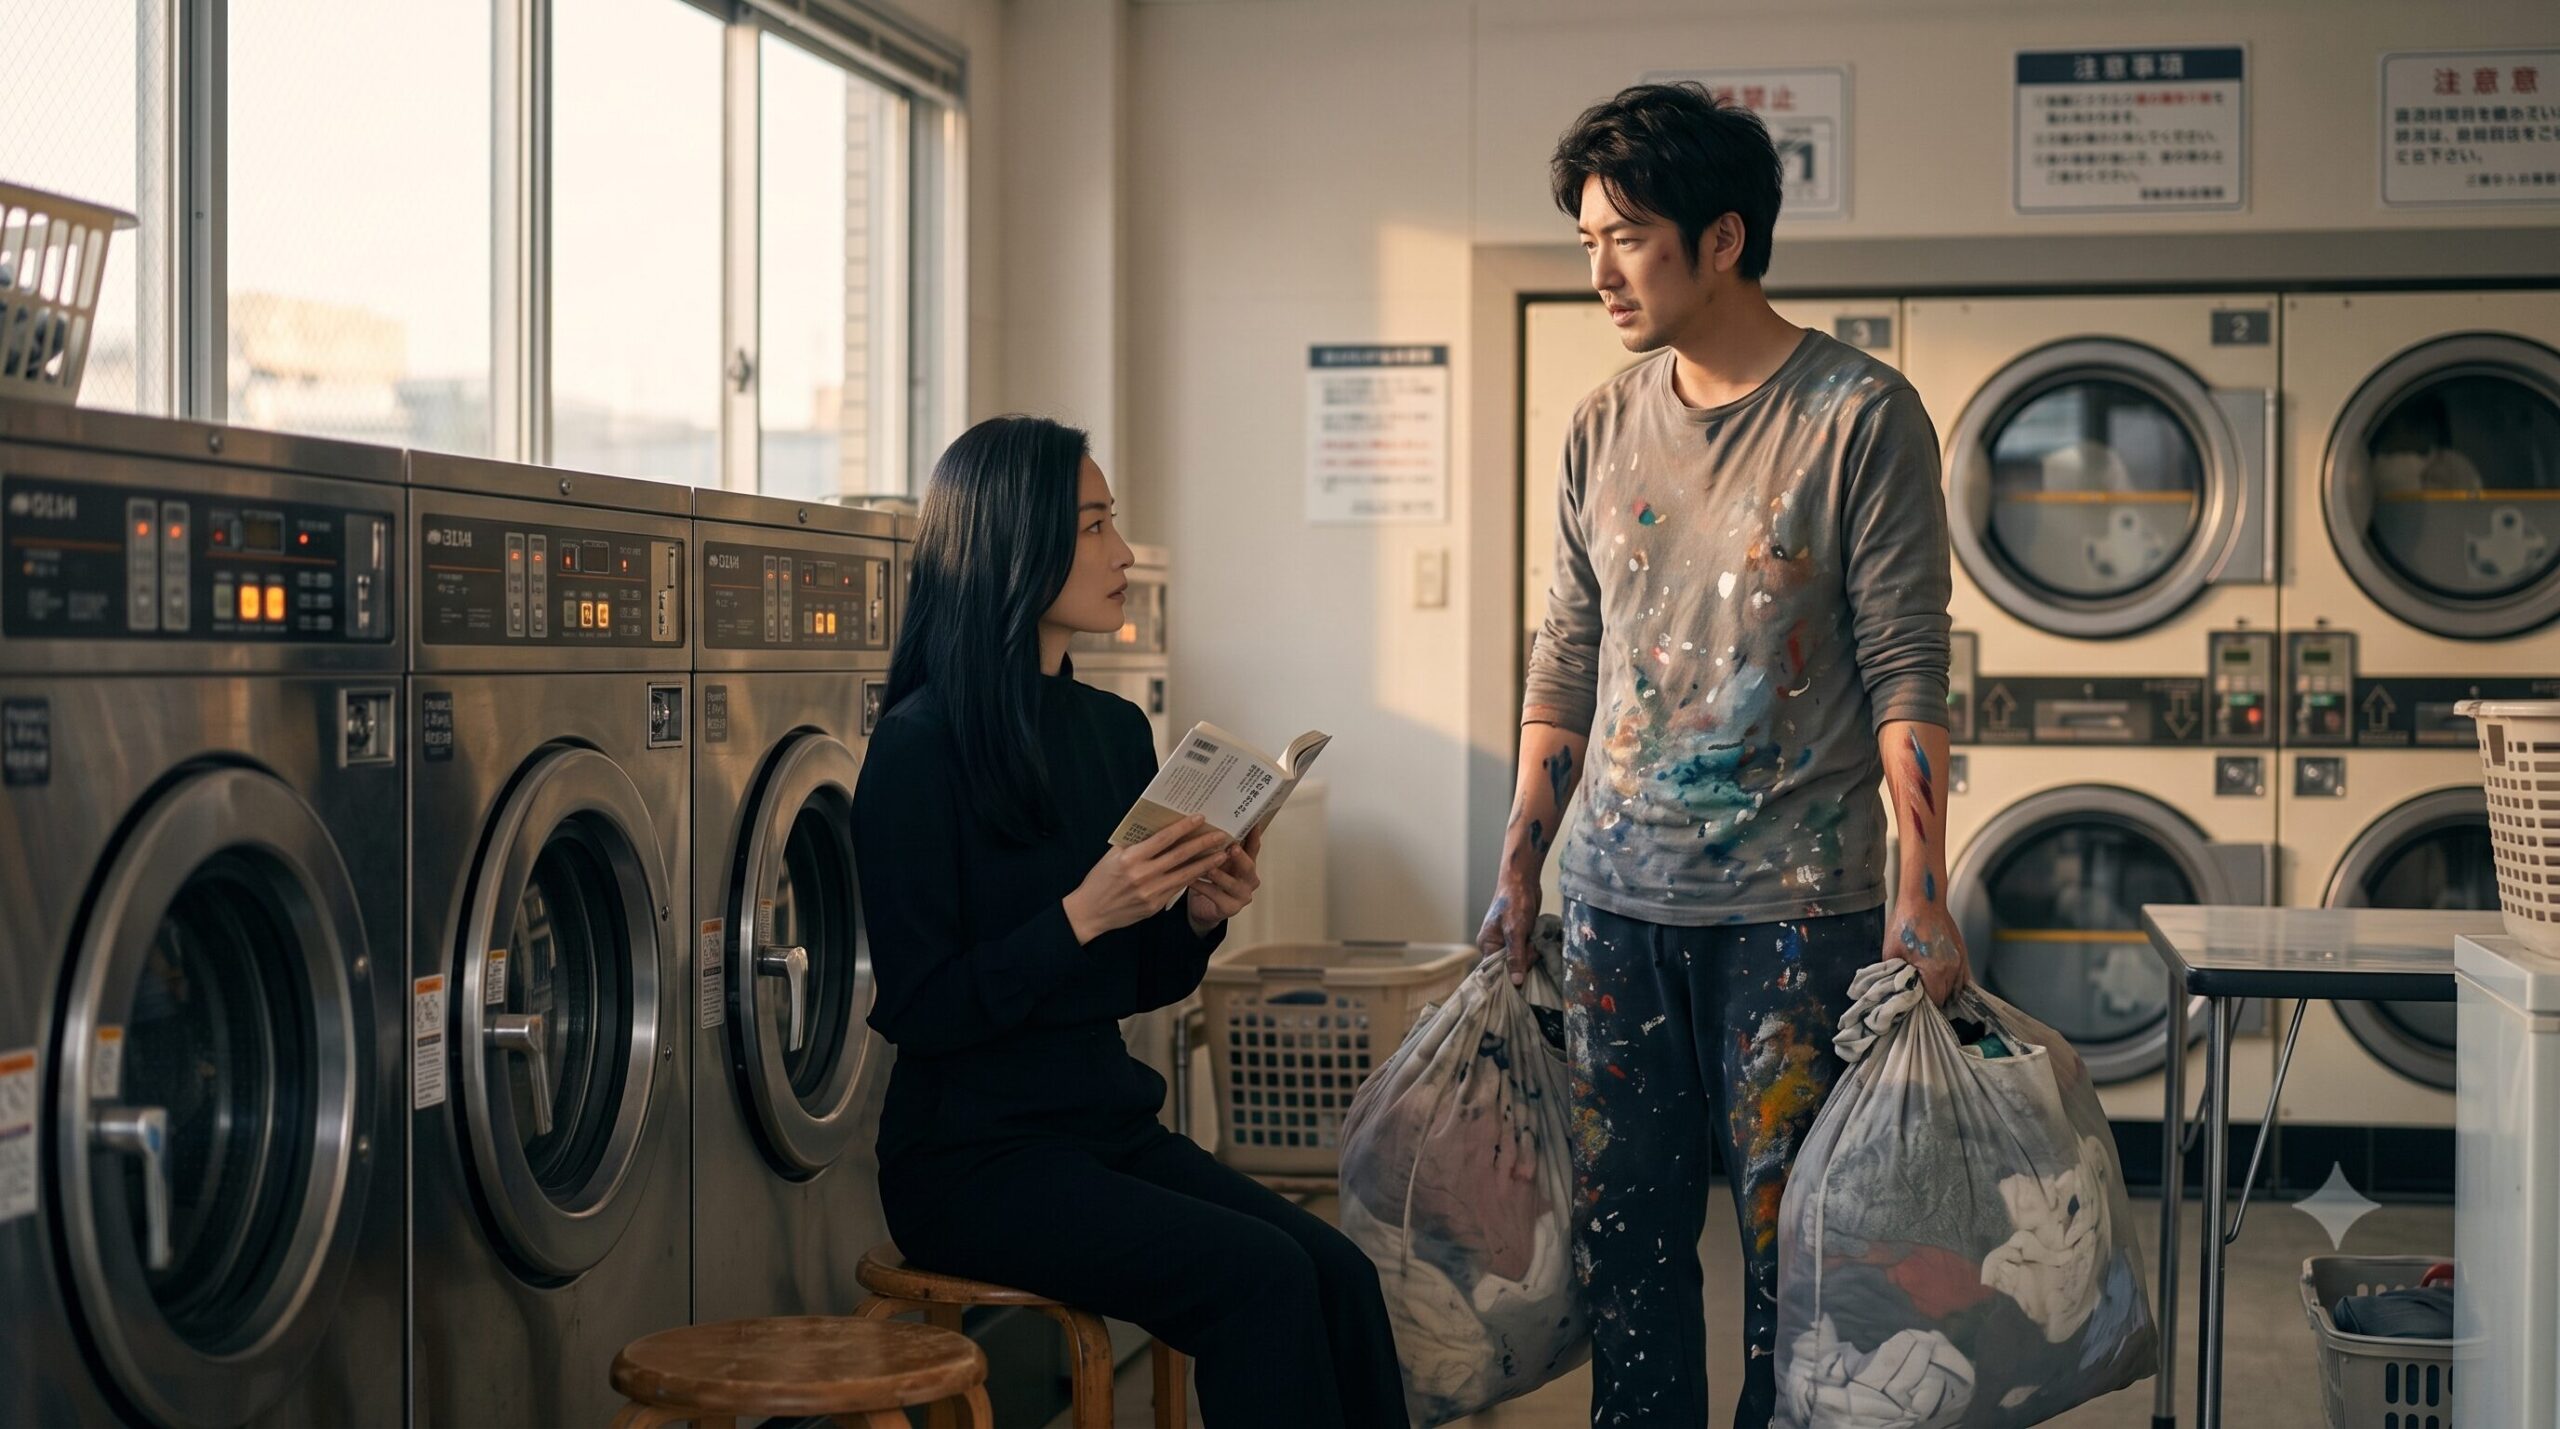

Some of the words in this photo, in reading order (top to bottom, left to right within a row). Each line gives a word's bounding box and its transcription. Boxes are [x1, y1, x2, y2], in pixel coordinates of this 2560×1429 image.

[2073, 53, 2184, 80] 注意事項
[1853, 319, 1872, 347] 3
[2231, 314, 2250, 341] 2
